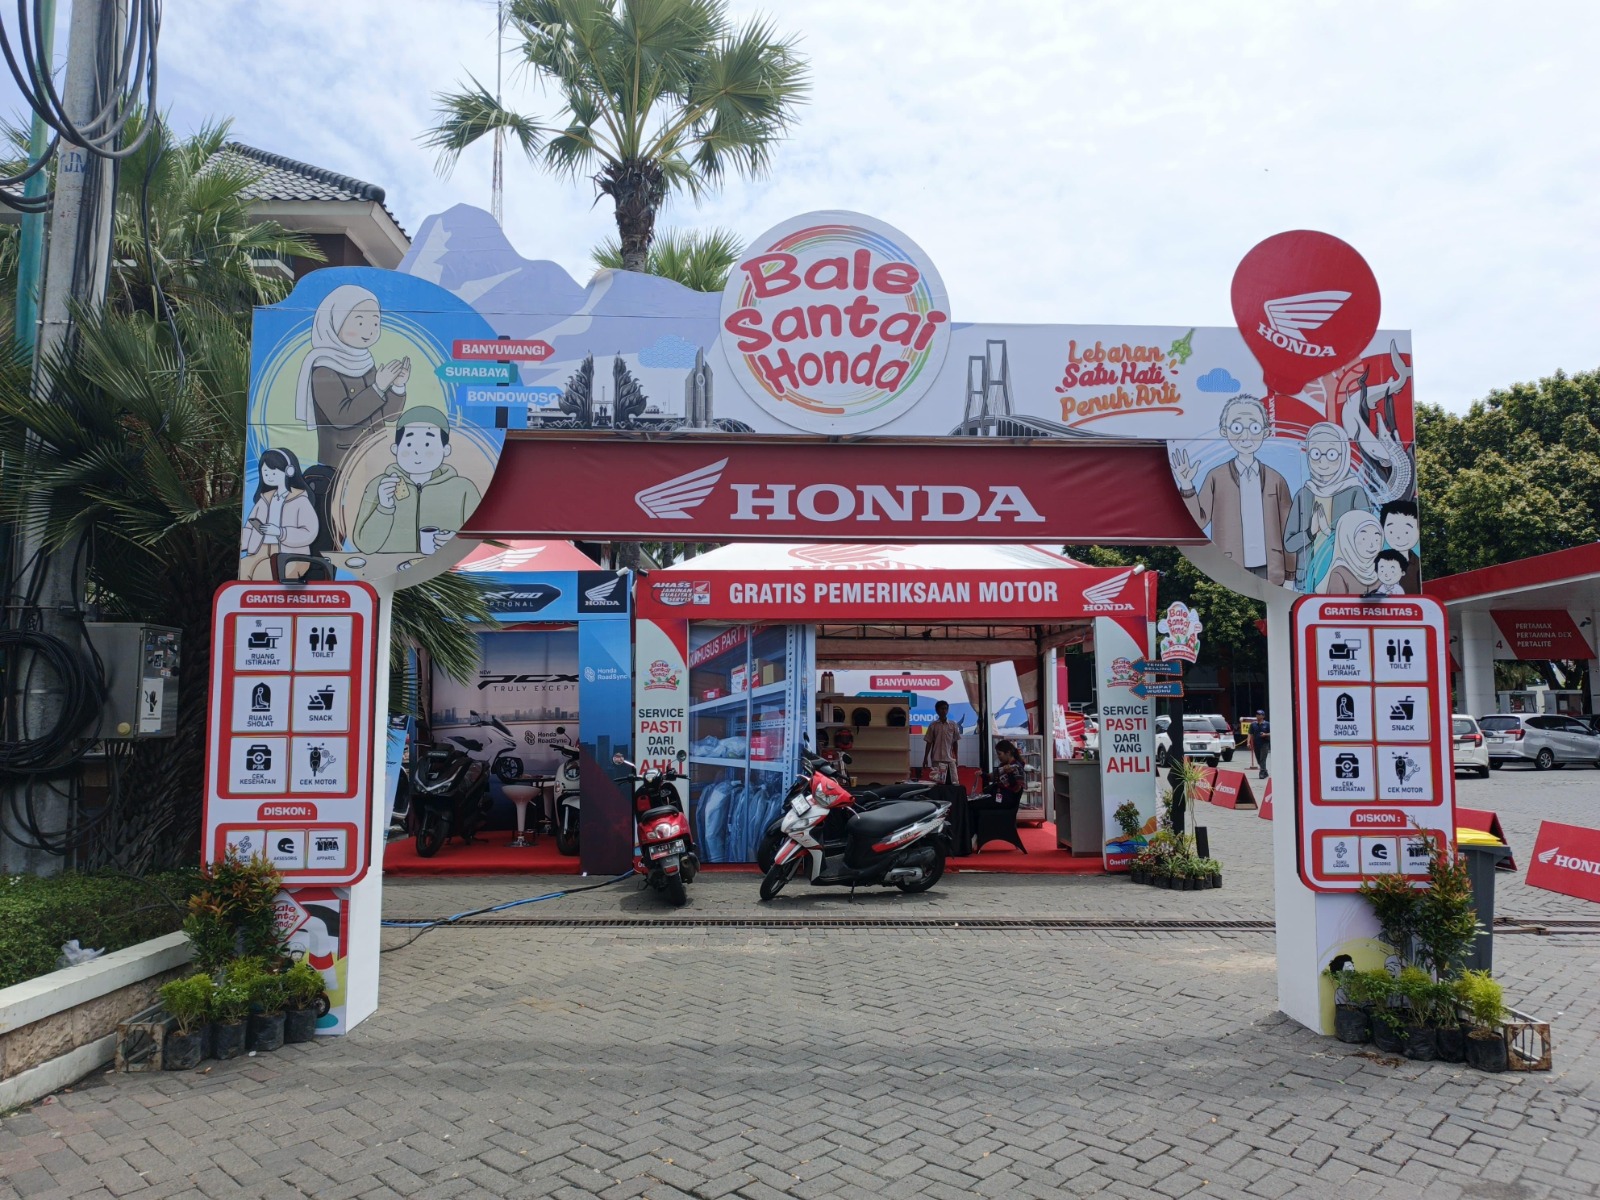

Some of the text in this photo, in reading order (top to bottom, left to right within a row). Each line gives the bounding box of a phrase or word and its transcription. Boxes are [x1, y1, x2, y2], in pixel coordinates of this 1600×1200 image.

[740, 248, 920, 299] Bale
[724, 295, 947, 353] Santai
[1256, 321, 1337, 358] HONDA
[462, 343, 545, 356] BANYUWANGI
[1068, 340, 1165, 364] Lebaran
[445, 366, 509, 378] SURABAYA
[757, 343, 910, 394] Honda
[1062, 361, 1165, 388] Satu Hati
[467, 390, 558, 403] BONDOWOSO
[1060, 383, 1181, 421] Penuh Arti
[730, 483, 1046, 522] HONDA
[729, 581, 1058, 604] GRATIS PEMERIKSAAN MOTOR
[246, 594, 285, 604] GRATIS
[286, 595, 340, 604] FASILITAS
[1083, 603, 1135, 611] HONDA
[1169, 608, 1188, 618] Bale
[1324, 607, 1361, 616] GRATIS
[1362, 607, 1412, 616] FASILITAS
[1495, 640, 1503, 650] 4
[477, 674, 579, 691] PCX
[597, 673, 628, 682] RoadSync
[876, 678, 940, 687] BANYUWANGI
[638, 708, 684, 718] SERVICE
[1102, 705, 1149, 716] SERVICE
[640, 720, 682, 734] PASTI
[1106, 718, 1147, 731] PASTI
[648, 736, 674, 745] DARI
[1114, 733, 1140, 743] DARI
[646, 746, 675, 756] YANG
[1113, 743, 1142, 753] YANG
[1106, 756, 1151, 773] AHLI
[263, 807, 306, 815] DISKON
[1356, 814, 1395, 823] DISKON
